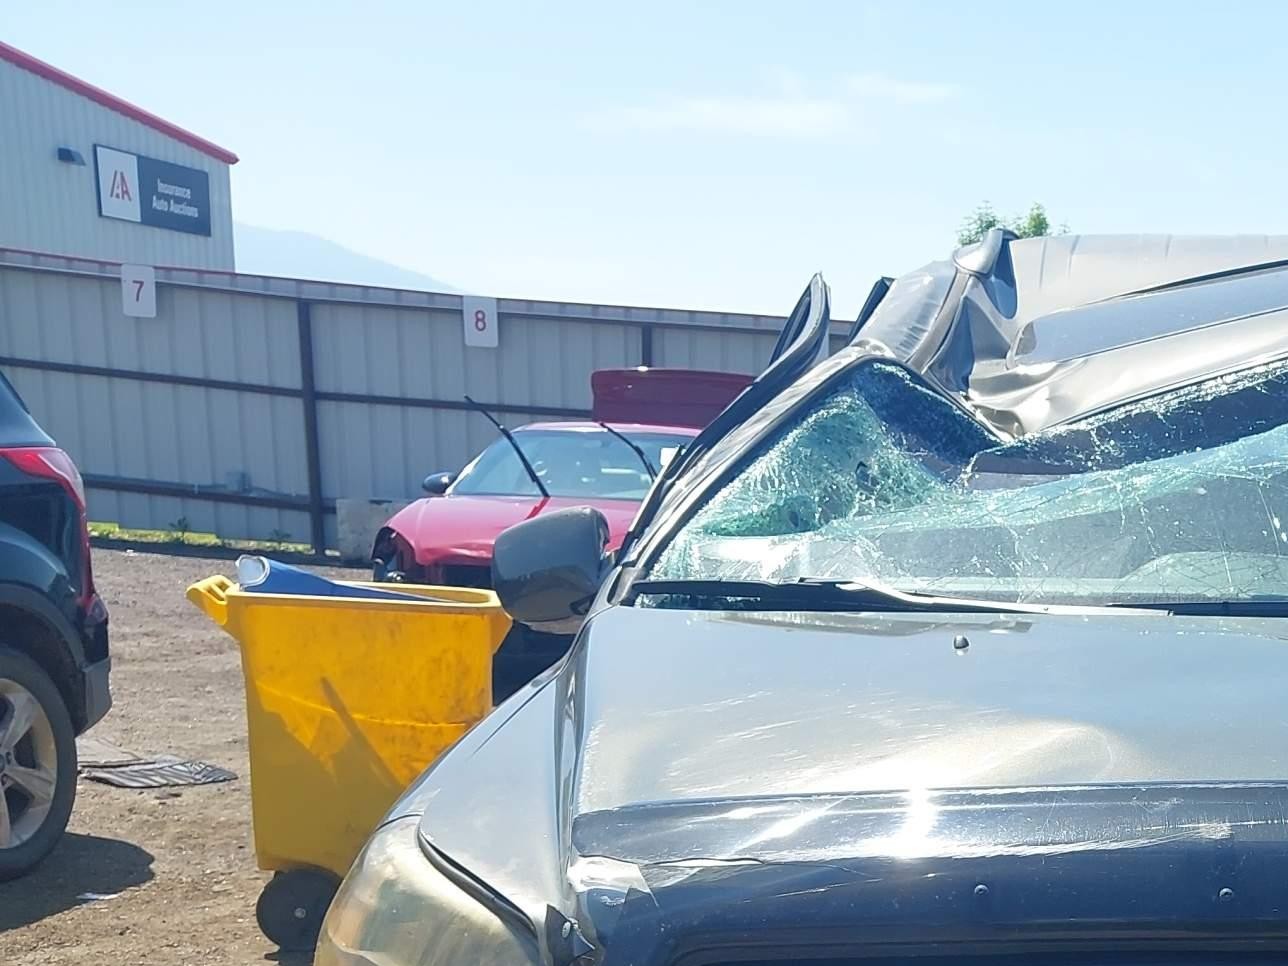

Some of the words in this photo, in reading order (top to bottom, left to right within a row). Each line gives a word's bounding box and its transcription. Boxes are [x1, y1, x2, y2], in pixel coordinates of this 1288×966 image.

[152, 195, 168, 212] Auto
[133, 280, 144, 302] 7
[475, 310, 487, 332] 8
